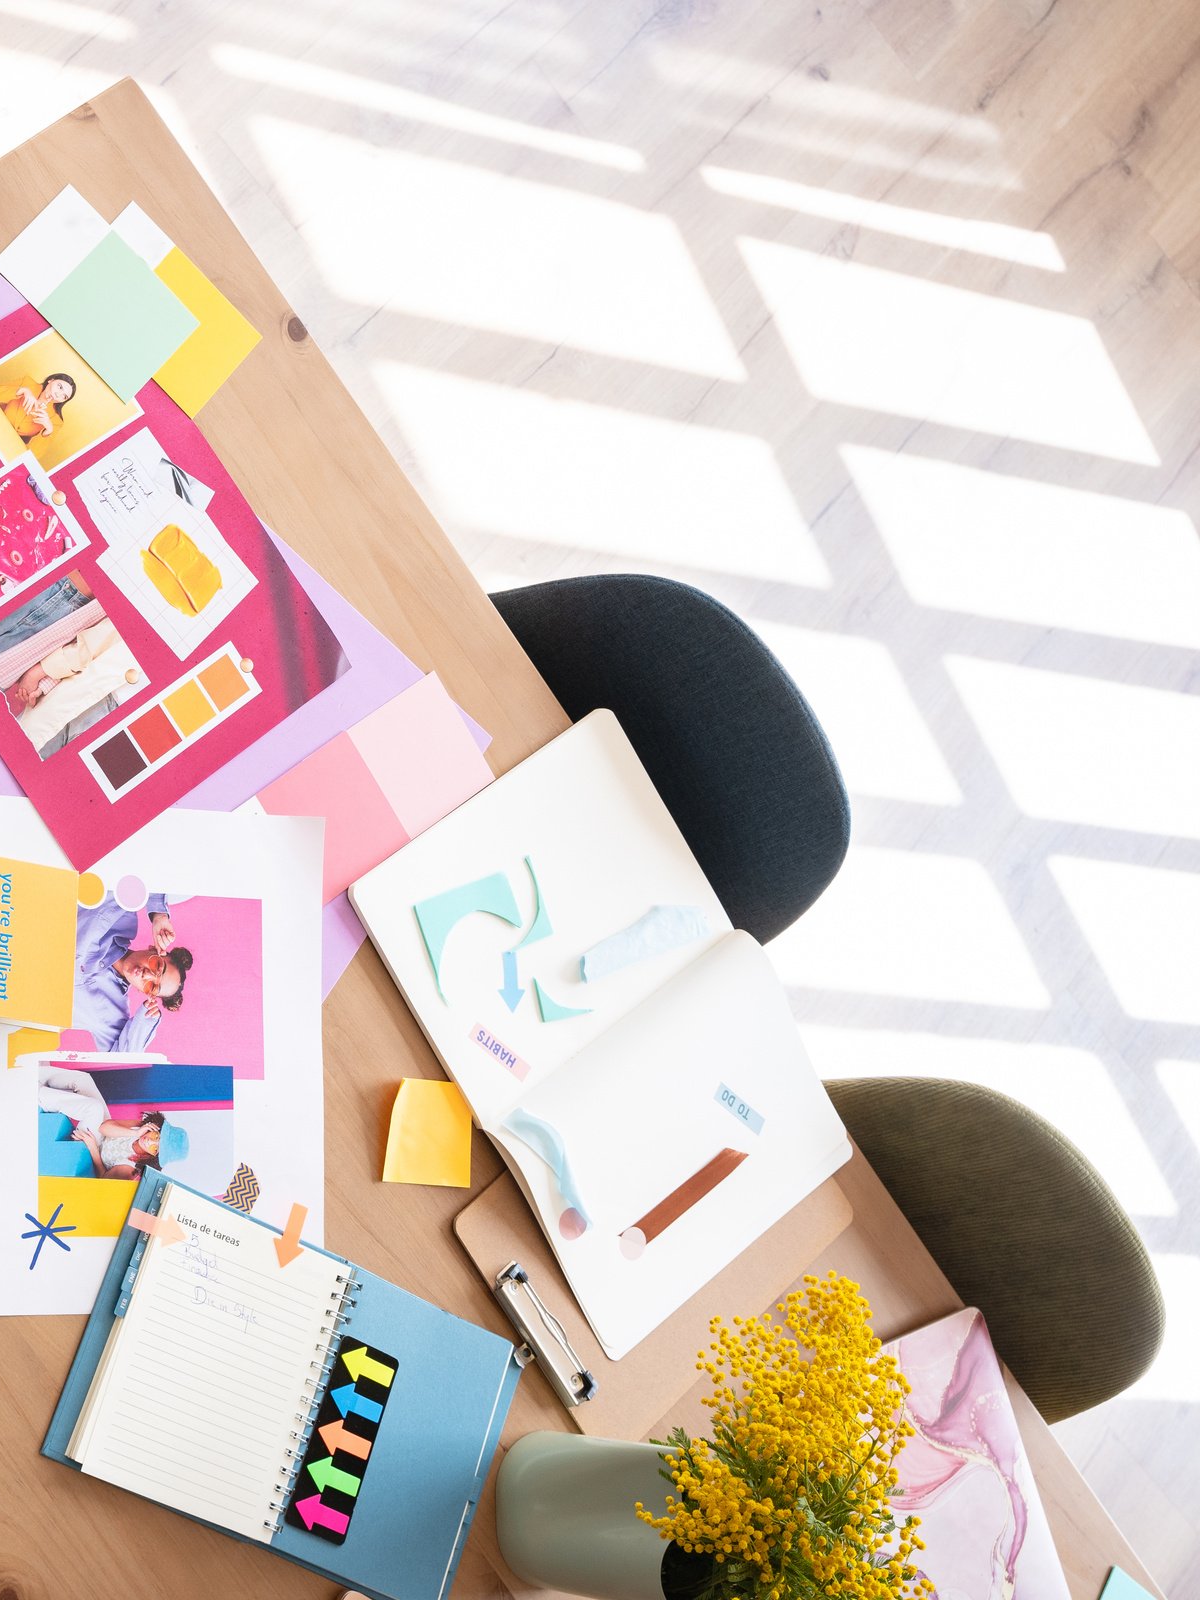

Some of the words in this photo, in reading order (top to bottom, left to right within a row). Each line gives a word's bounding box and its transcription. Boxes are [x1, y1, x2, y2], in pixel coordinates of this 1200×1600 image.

[476, 1030, 517, 1068] HABITS
[722, 1090, 736, 1107] DO
[738, 1103, 750, 1121] TO
[177, 1213, 198, 1229] Lista
[200, 1223, 211, 1235] de
[213, 1229, 241, 1247] tareas
